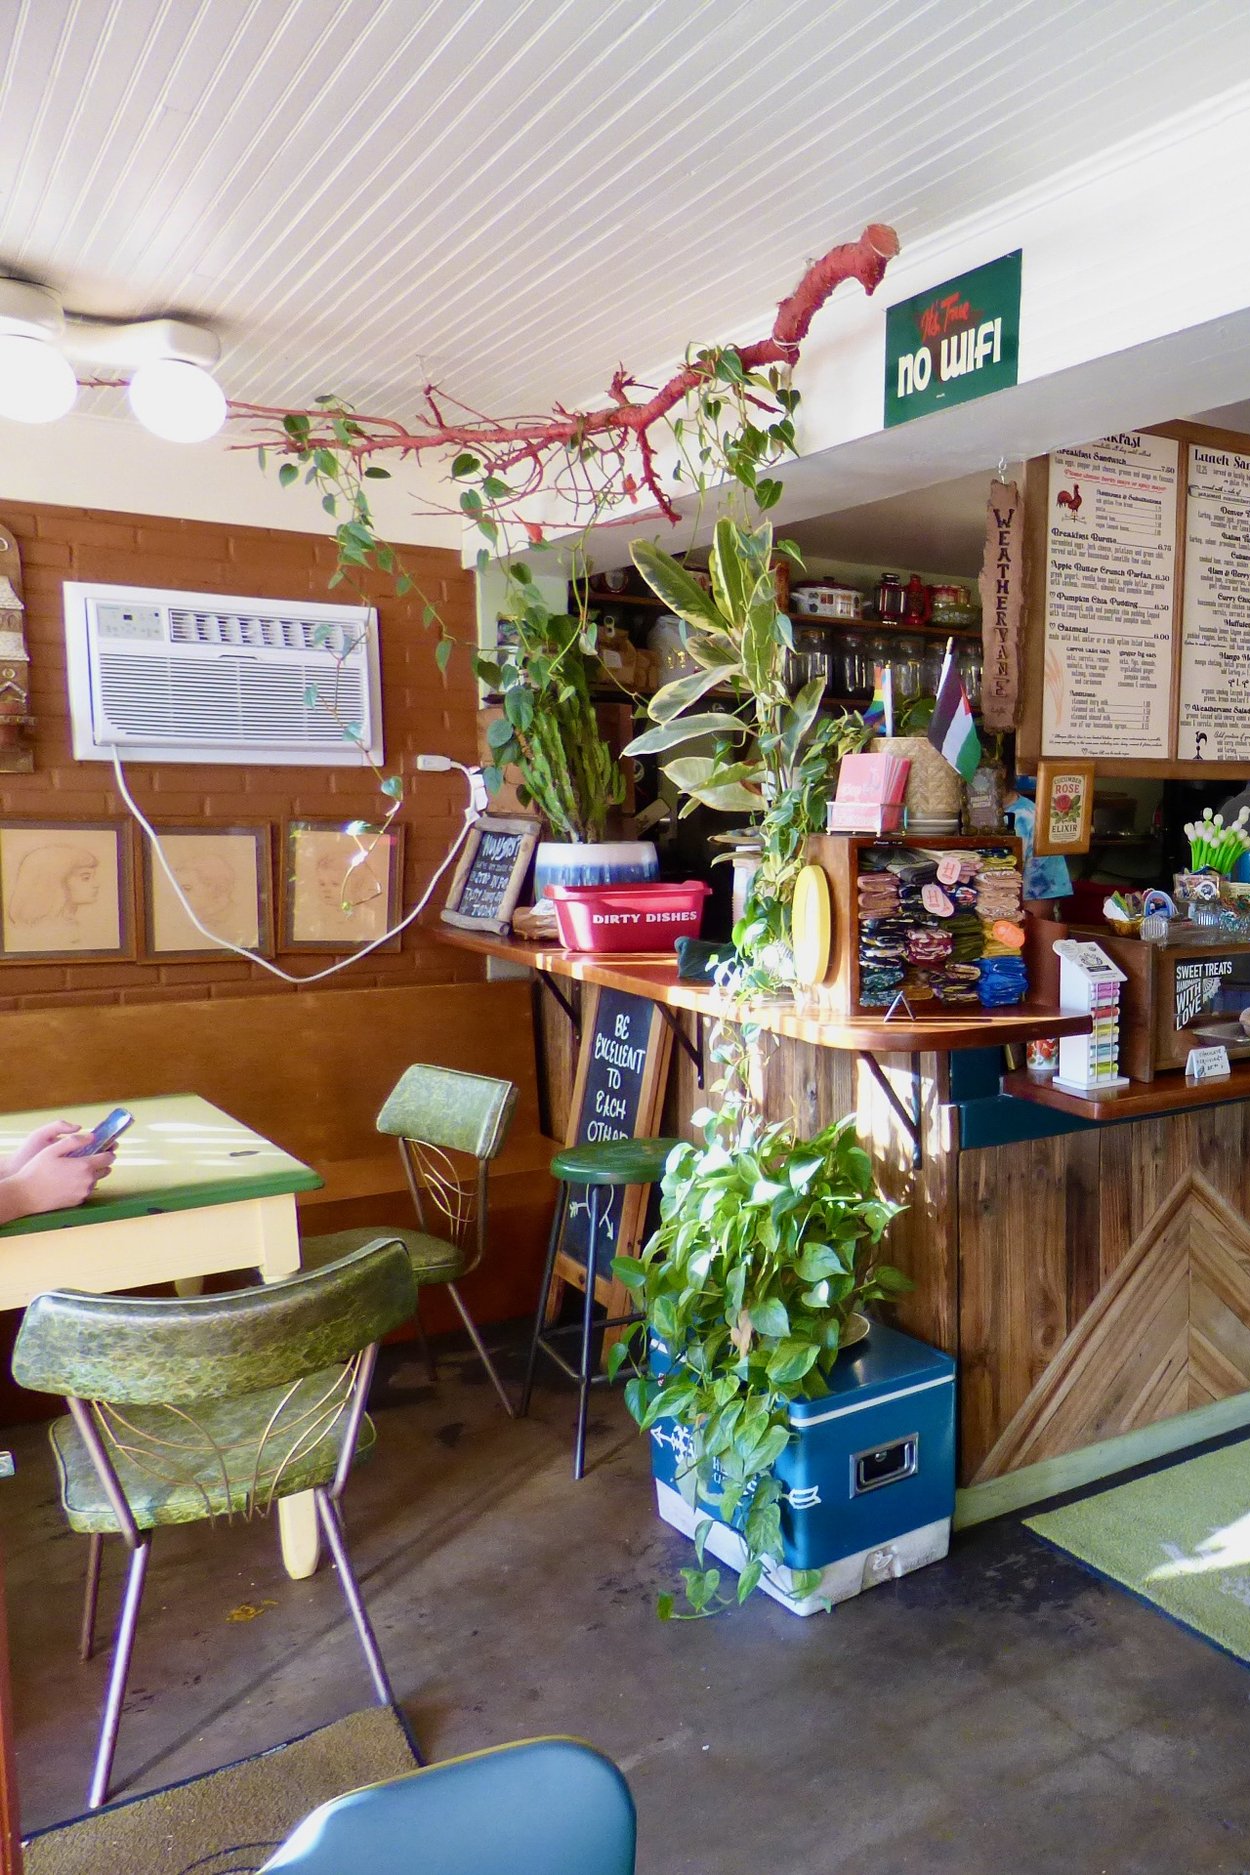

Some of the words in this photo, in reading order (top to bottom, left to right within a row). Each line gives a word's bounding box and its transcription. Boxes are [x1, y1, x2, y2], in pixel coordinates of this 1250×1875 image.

[1194, 448, 1229, 467] Lunch
[1220, 505, 1243, 517] Denver
[1051, 527, 1088, 540] Breakfast
[1051, 560, 1071, 571] Apple
[1073, 562, 1098, 573] Butter
[1100, 565, 1125, 576] Crunch
[1207, 566, 1223, 575] Ham
[1230, 569, 1249, 579] Berry
[993, 508, 1014, 698] WEATHERVANE
[1056, 592, 1089, 604] Pumpkin
[1109, 597, 1138, 608] Pudding
[1217, 592, 1235, 602] Curry
[1057, 623, 1088, 633] Oatmeal
[1218, 652, 1240, 661] Mango
[1191, 704, 1232, 713] Weathervane
[1233, 706, 1250, 714] Salad
[1055, 784, 1080, 794] ROSE
[1051, 824, 1078, 833] ELIXIR
[592, 913, 641, 924] DIRTY
[646, 911, 697, 923] DISHES
[1176, 963, 1204, 980] SWEET
[1204, 961, 1233, 977] TREATS
[1176, 981, 1201, 1015] WITH
[1176, 993, 1202, 1031] LOVE
[614, 1013, 631, 1040] BE
[594, 1032, 646, 1075] EXCELLENT
[606, 1067, 622, 1090] TO
[595, 1091, 627, 1120] EACH
